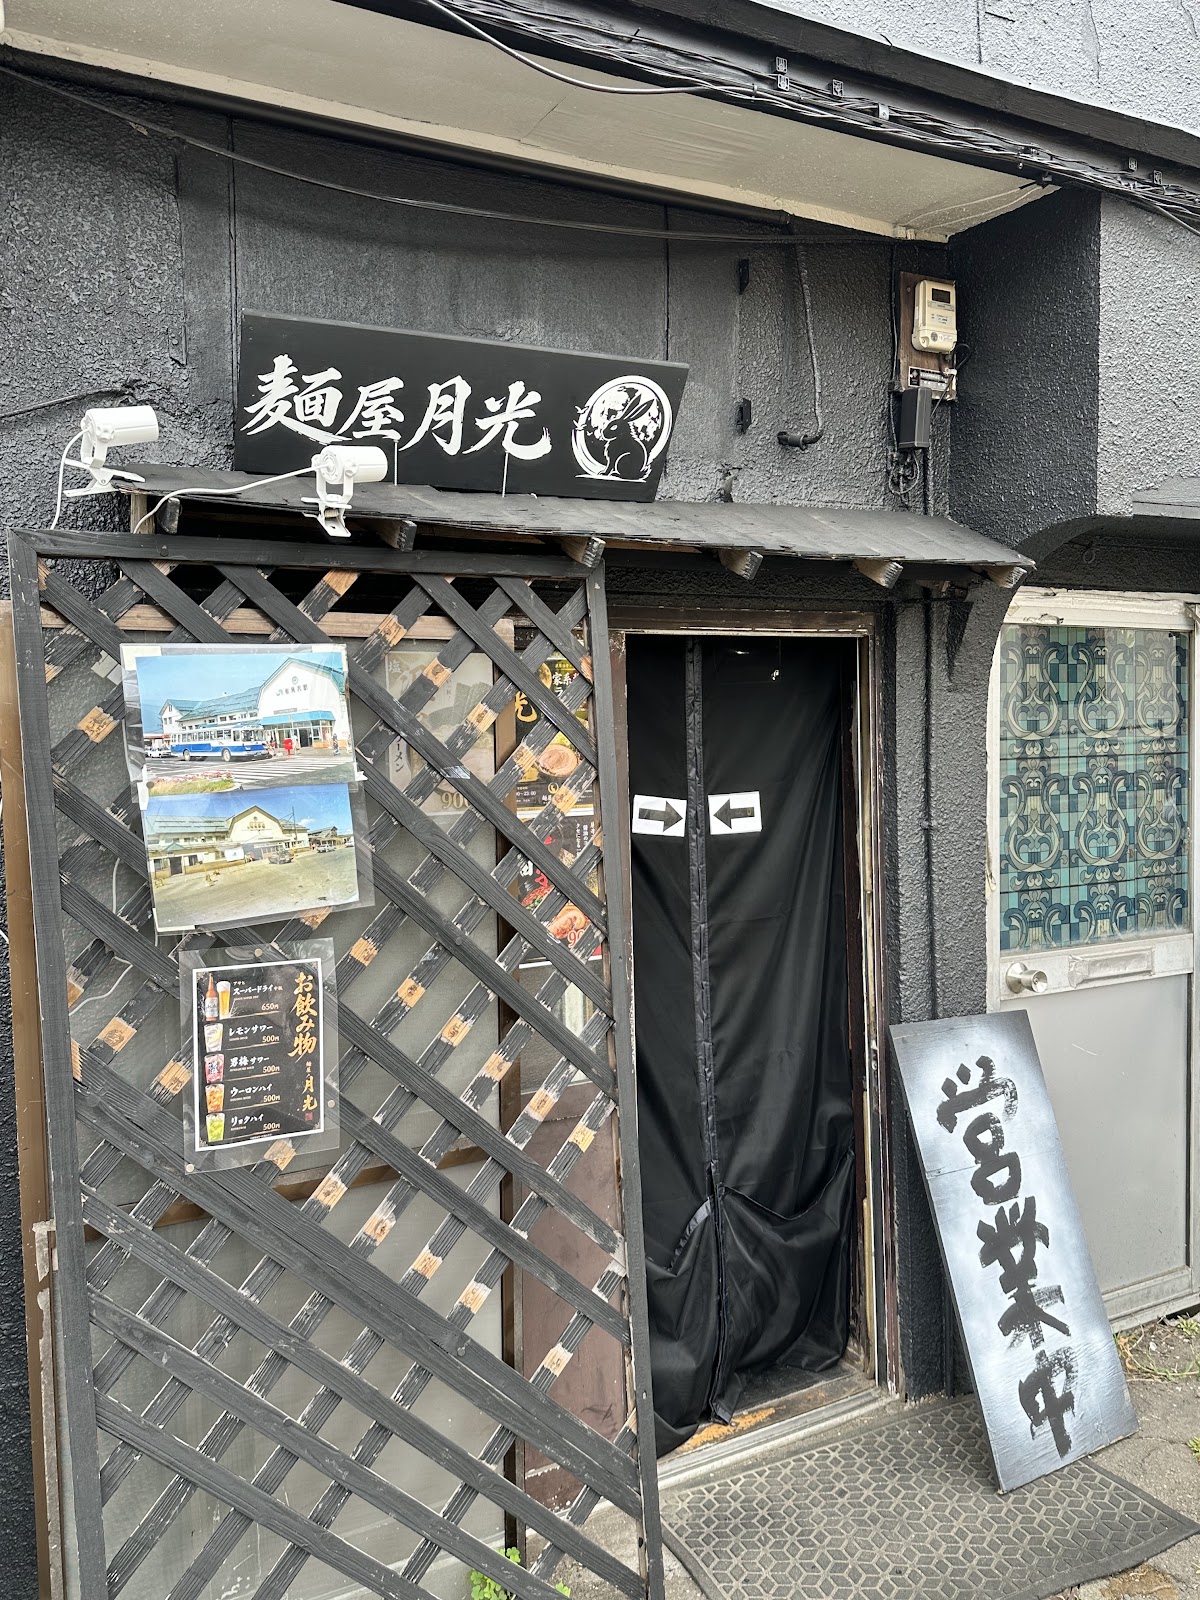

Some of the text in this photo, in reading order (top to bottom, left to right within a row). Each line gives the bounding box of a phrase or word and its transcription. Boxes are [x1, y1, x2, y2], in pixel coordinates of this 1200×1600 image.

[240, 353, 553, 461] 麺屋月光
[394, 735, 405, 773] ーメン
[261, 1003, 279, 1011] 650円
[288, 971, 318, 1063] お飲み物
[228, 1024, 273, 1037] レモンサワー
[262, 1034, 280, 1043] 500円
[229, 1055, 270, 1068] 男梅サワー
[262, 1064, 280, 1074] 500円
[230, 1083, 273, 1098] ウーロンハイ
[263, 1094, 281, 1103] 500円
[230, 1113, 264, 1127] リョクハイ
[262, 1122, 281, 1131] 500円
[936, 1055, 1080, 1460] 営業中
